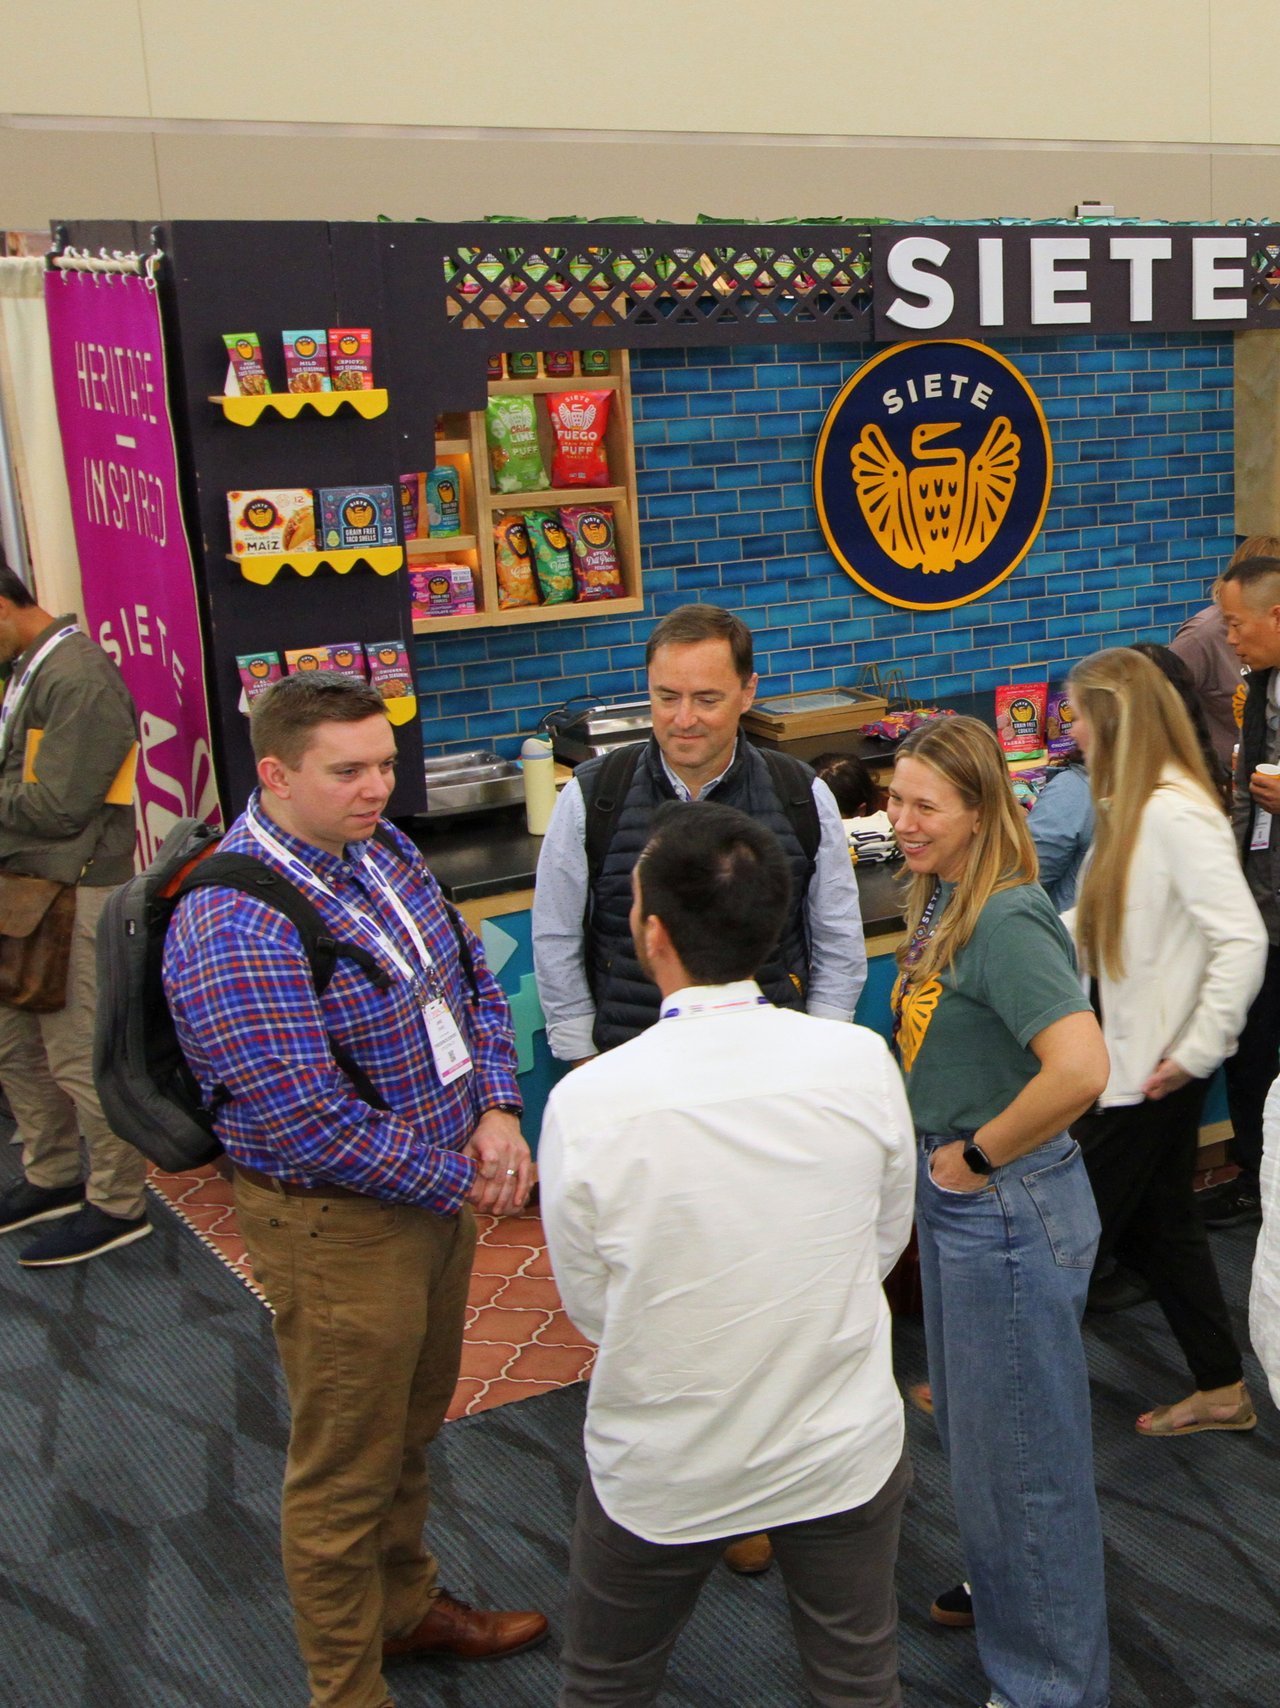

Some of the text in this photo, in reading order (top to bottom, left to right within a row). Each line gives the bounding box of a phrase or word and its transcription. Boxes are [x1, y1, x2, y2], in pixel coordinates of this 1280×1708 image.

[885, 237, 1248, 330] SIETE
[564, 394, 590, 403] SIETE
[882, 373, 993, 414] SIETE
[510, 432, 536, 442] LIME
[557, 430, 598, 440] FUEGO
[512, 446, 539, 456] PUFF
[561, 446, 594, 455] PUFF
[294, 496, 305, 504] 12
[345, 527, 376, 536] GRAIN FREE
[383, 526, 393, 534] 12
[99, 603, 186, 706] SIETE
[921, 886, 940, 924] SIETE
